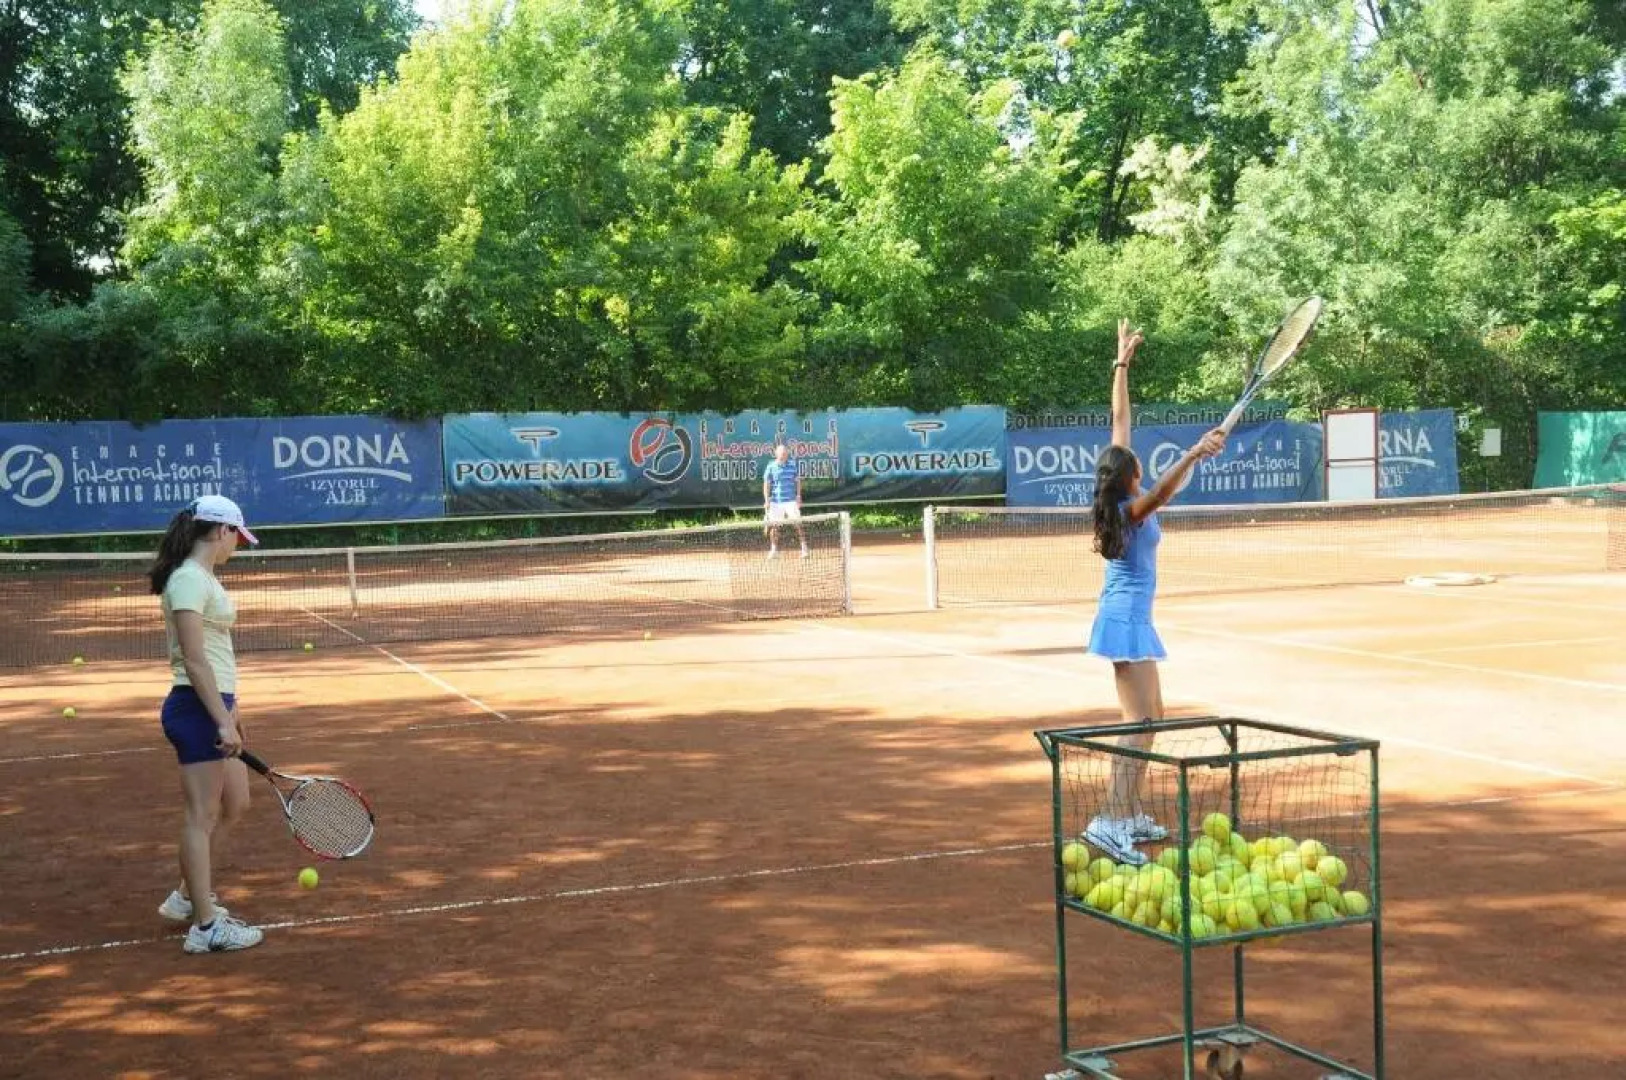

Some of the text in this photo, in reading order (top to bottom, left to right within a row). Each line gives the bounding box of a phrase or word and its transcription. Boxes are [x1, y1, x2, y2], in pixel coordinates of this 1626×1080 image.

[700, 418, 838, 435] ENACHE
[272, 431, 410, 469] DORNA
[1237, 439, 1303, 453] ACHE
[1379, 428, 1432, 457] RNA
[702, 459, 839, 481] TENNIS DEMY
[853, 449, 1000, 475] POWERADE
[1014, 444, 1099, 474] DORN
[1200, 451, 1300, 476] International
[72, 457, 222, 484] International
[454, 458, 622, 483] POWERADE
[74, 482, 222, 504] TENNIS ACADEMY
[311, 477, 380, 491] IZVORUL
[1201, 472, 1300, 492] TENNIS ACADEMY
[325, 487, 368, 505] ALB
[1056, 493, 1088, 506] ALB
